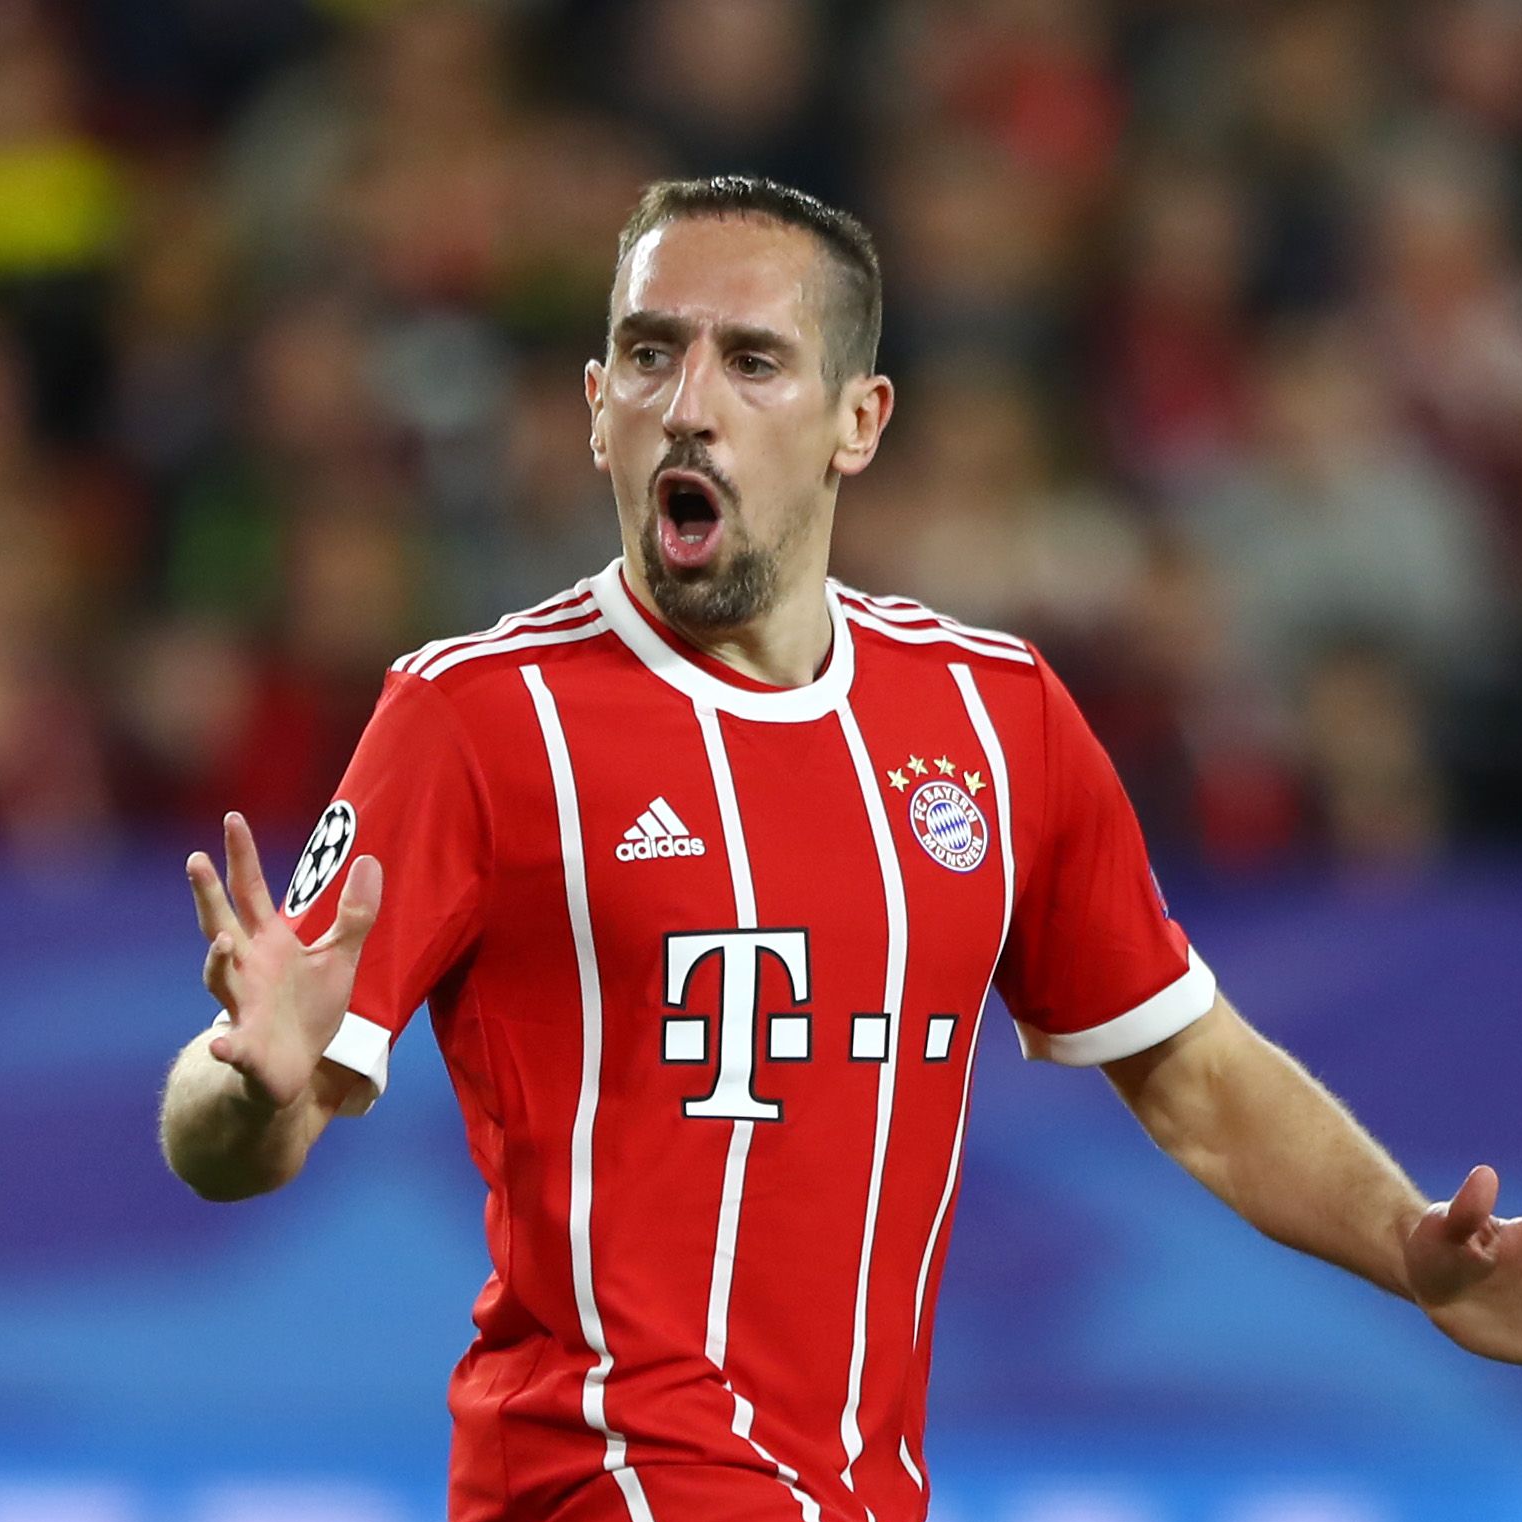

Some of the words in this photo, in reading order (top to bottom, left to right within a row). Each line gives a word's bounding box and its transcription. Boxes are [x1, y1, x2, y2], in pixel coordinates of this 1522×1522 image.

[914, 799, 928, 821] FC
[921, 786, 979, 823] BAYERN
[616, 835, 706, 862] adidas
